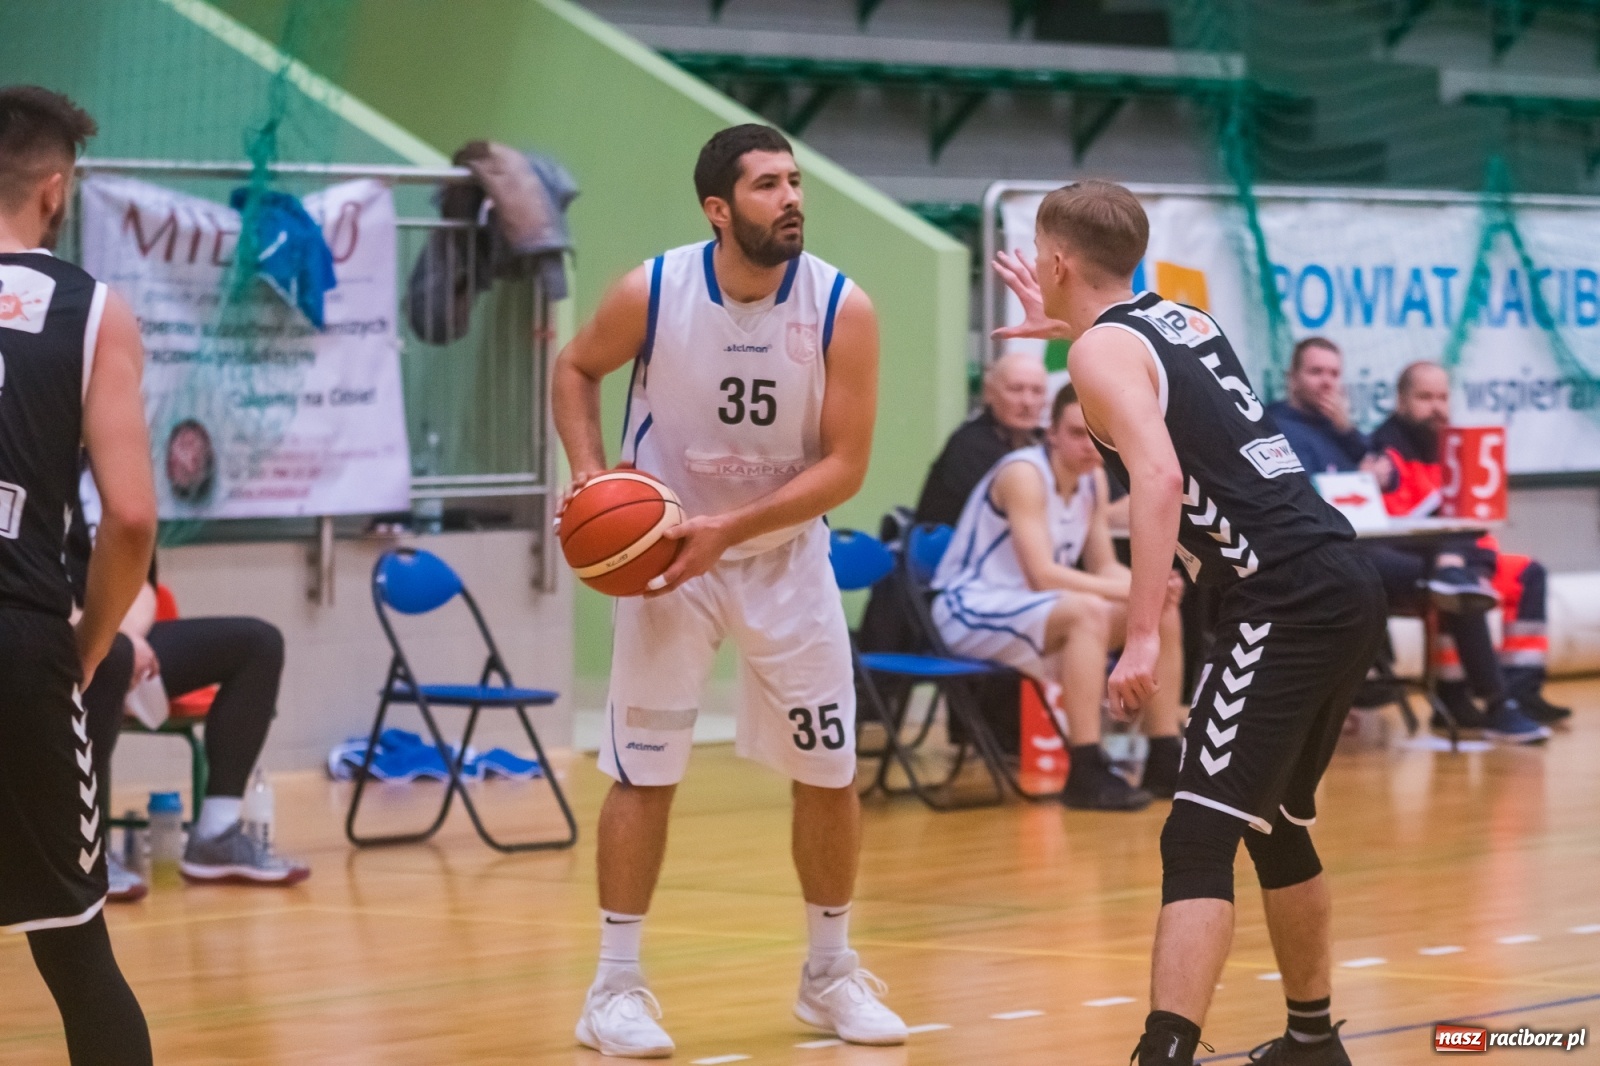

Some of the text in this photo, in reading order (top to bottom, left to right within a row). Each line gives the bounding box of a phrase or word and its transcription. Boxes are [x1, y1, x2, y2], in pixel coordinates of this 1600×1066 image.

[1268, 264, 1600, 329] POWIAT ACIB
[718, 376, 777, 426] 35
[1199, 352, 1264, 422] 5
[721, 464, 806, 476] KAMPKA
[1471, 433, 1500, 499] 5
[788, 702, 846, 751] 35
